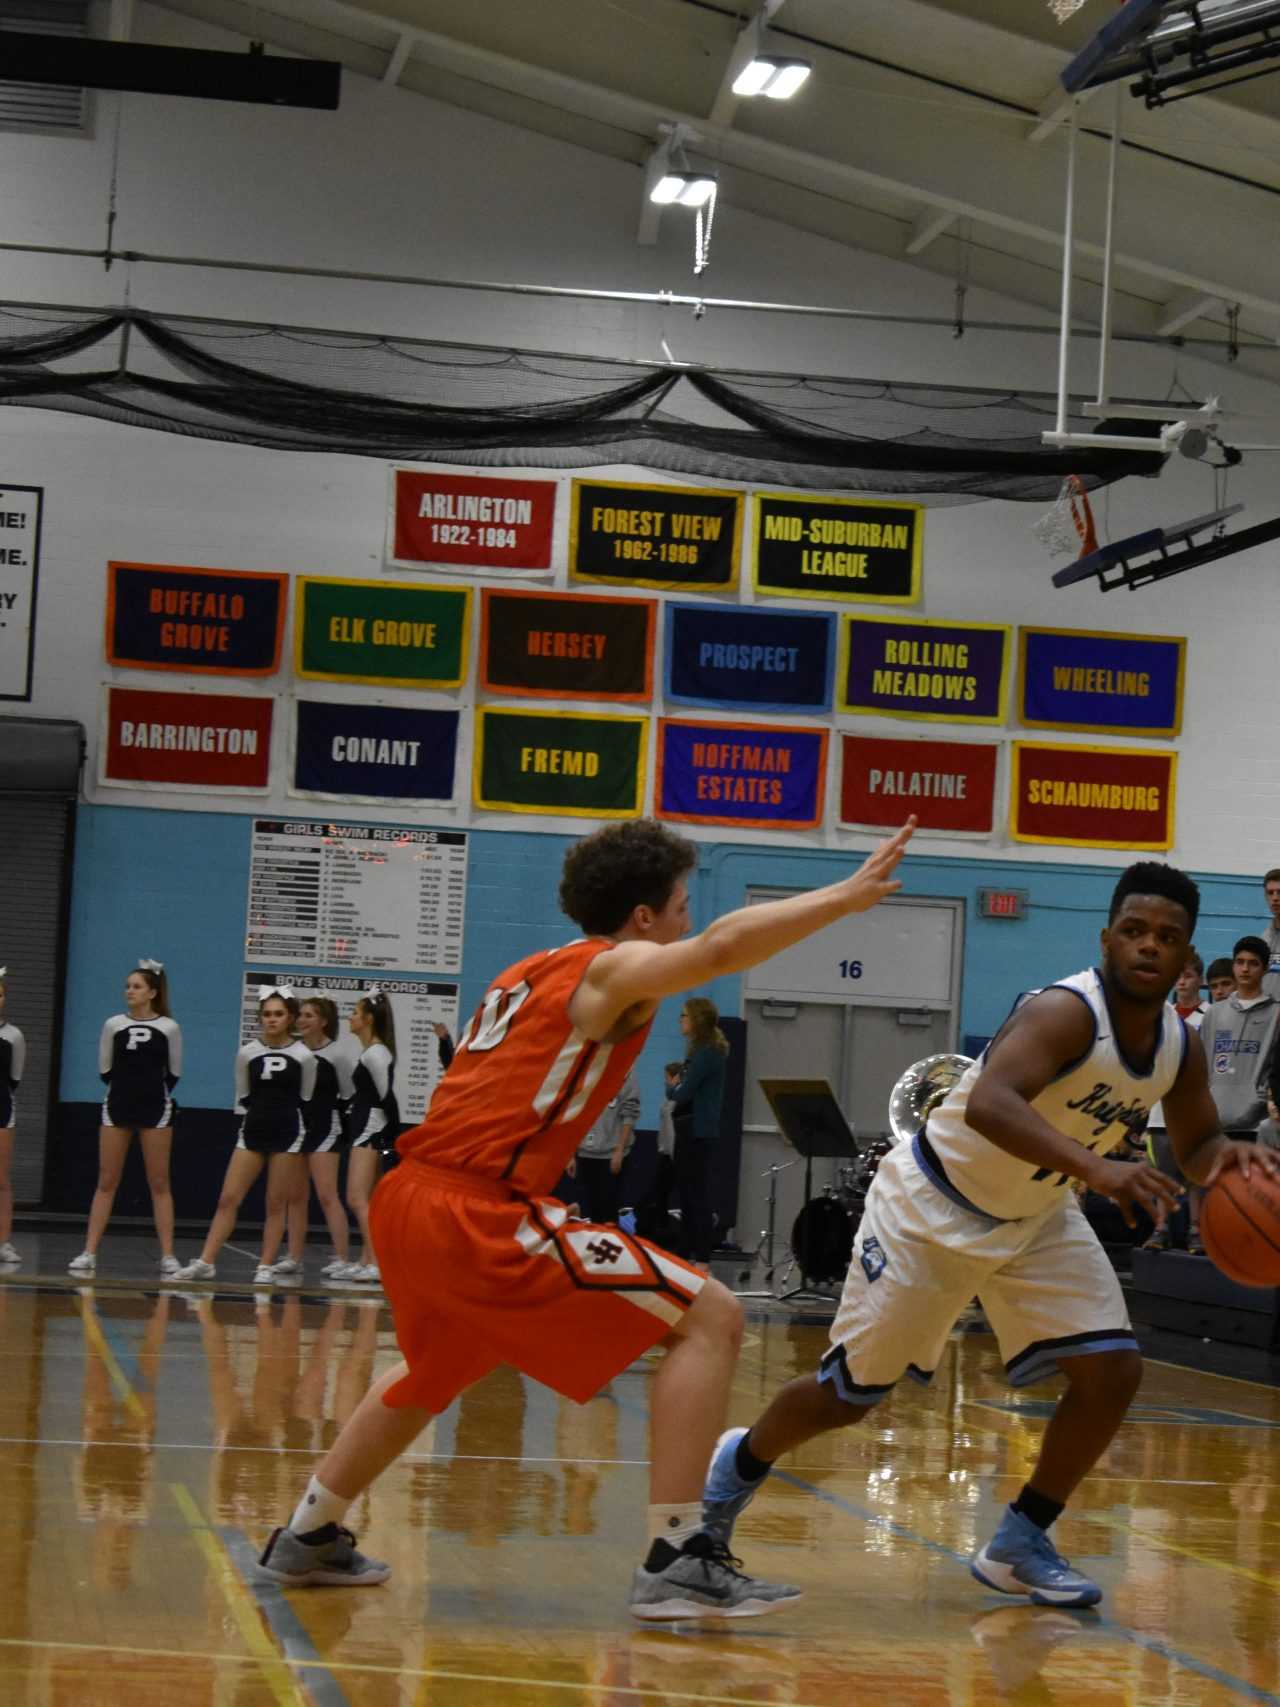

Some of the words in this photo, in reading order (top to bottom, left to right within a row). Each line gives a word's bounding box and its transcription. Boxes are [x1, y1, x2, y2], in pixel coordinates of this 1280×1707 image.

[419, 493, 531, 525] ARLINGTON
[432, 525, 516, 548] 1922-1984
[592, 508, 664, 536] FOREST
[672, 514, 721, 540] VIEW
[765, 515, 907, 549] MID-SUBURBAN
[613, 539, 699, 564] 1962-1986
[802, 550, 867, 578] LEAGUE
[150, 589, 244, 620] BUFFALO
[161, 623, 228, 651] GROVE
[330, 617, 365, 643] ELK
[373, 620, 437, 649] GROVE
[528, 632, 606, 659] HERSEY
[700, 643, 798, 672] PROSPECT
[885, 640, 968, 668] ROLLING
[873, 670, 976, 700] MEADOWS
[1054, 667, 1149, 696] WHEELING
[121, 722, 257, 754] BARRINGTON
[332, 736, 420, 765] CONANT
[522, 748, 598, 776] FREMD
[693, 744, 790, 773] HOFFMAN
[697, 775, 782, 804] ESTATES
[870, 770, 966, 799] PALATINE
[1029, 780, 1159, 811] SCHAUMBURG
[283, 824, 323, 836] GIRLS
[327, 824, 369, 838] SWIM
[373, 829, 438, 843] RECORDS
[839, 960, 863, 979] 16
[276, 975, 313, 987] BOYS
[318, 978, 360, 990] SWIM
[363, 981, 429, 994] RECORDS
[126, 1028, 151, 1050] P
[260, 1056, 287, 1080] P
